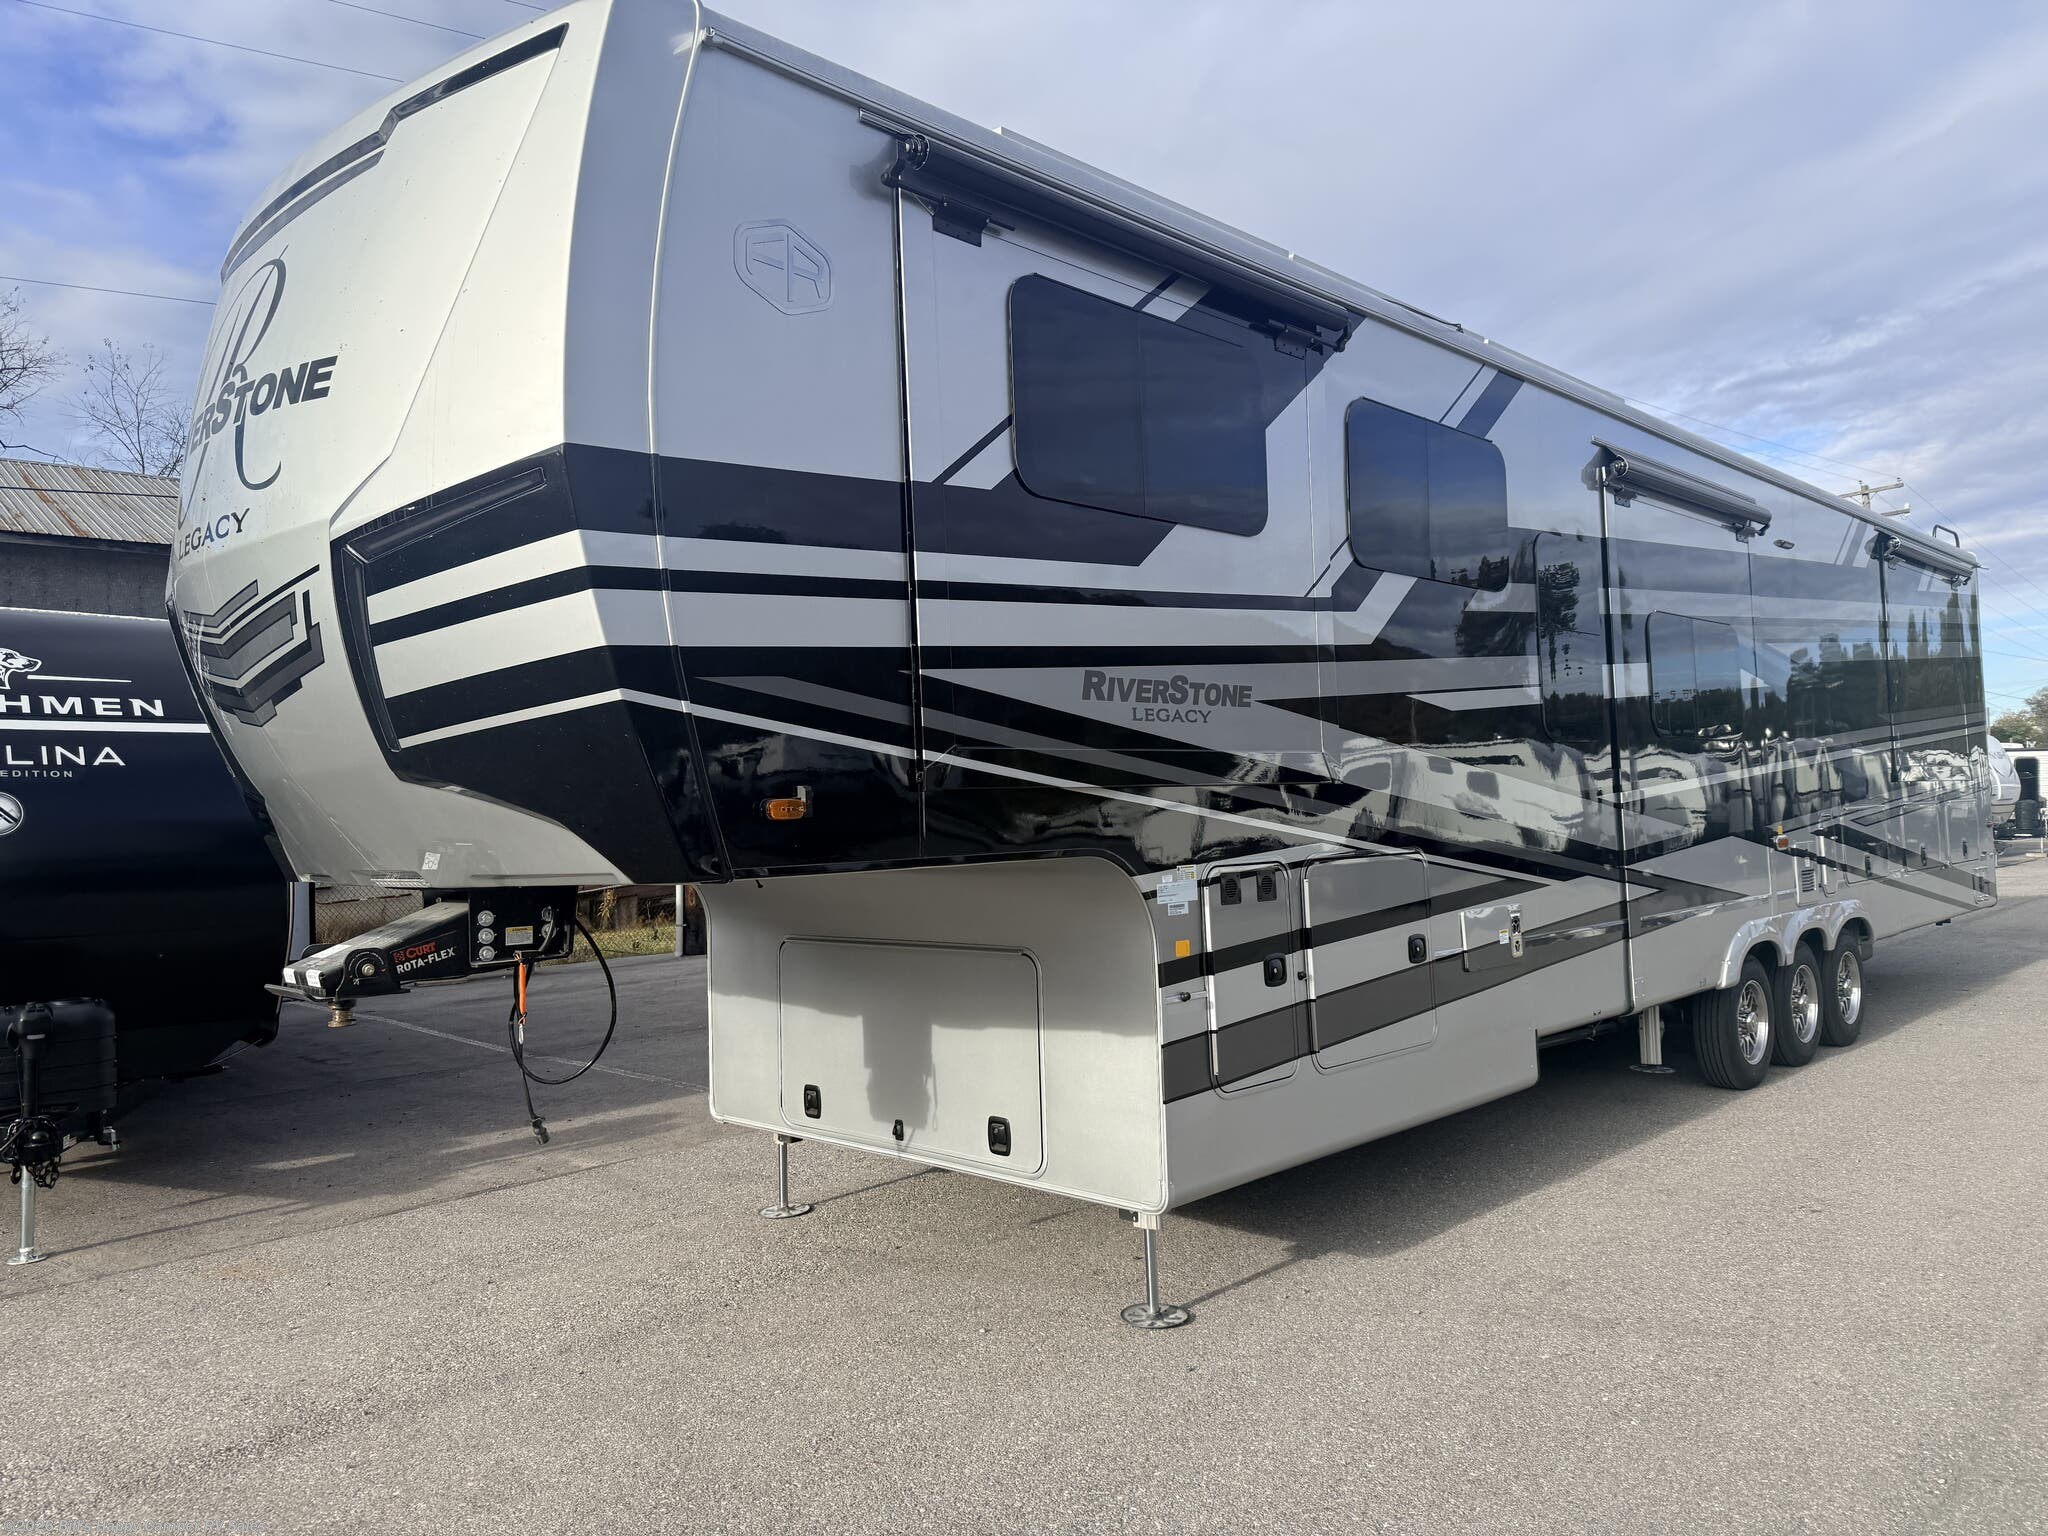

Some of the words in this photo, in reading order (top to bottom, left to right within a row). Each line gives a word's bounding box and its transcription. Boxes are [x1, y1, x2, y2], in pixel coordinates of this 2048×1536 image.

[187, 355, 338, 456] ERSTONE
[178, 507, 250, 561] LEGACY
[1081, 669, 1253, 708] RIVERSTONE
[1132, 707, 1212, 723] LEGACY
[5, 745, 126, 766] LINA
[0, 769, 73, 778] EDITION
[396, 946, 456, 975] ROTA-FLEX
[406, 942, 437, 959] CURT
